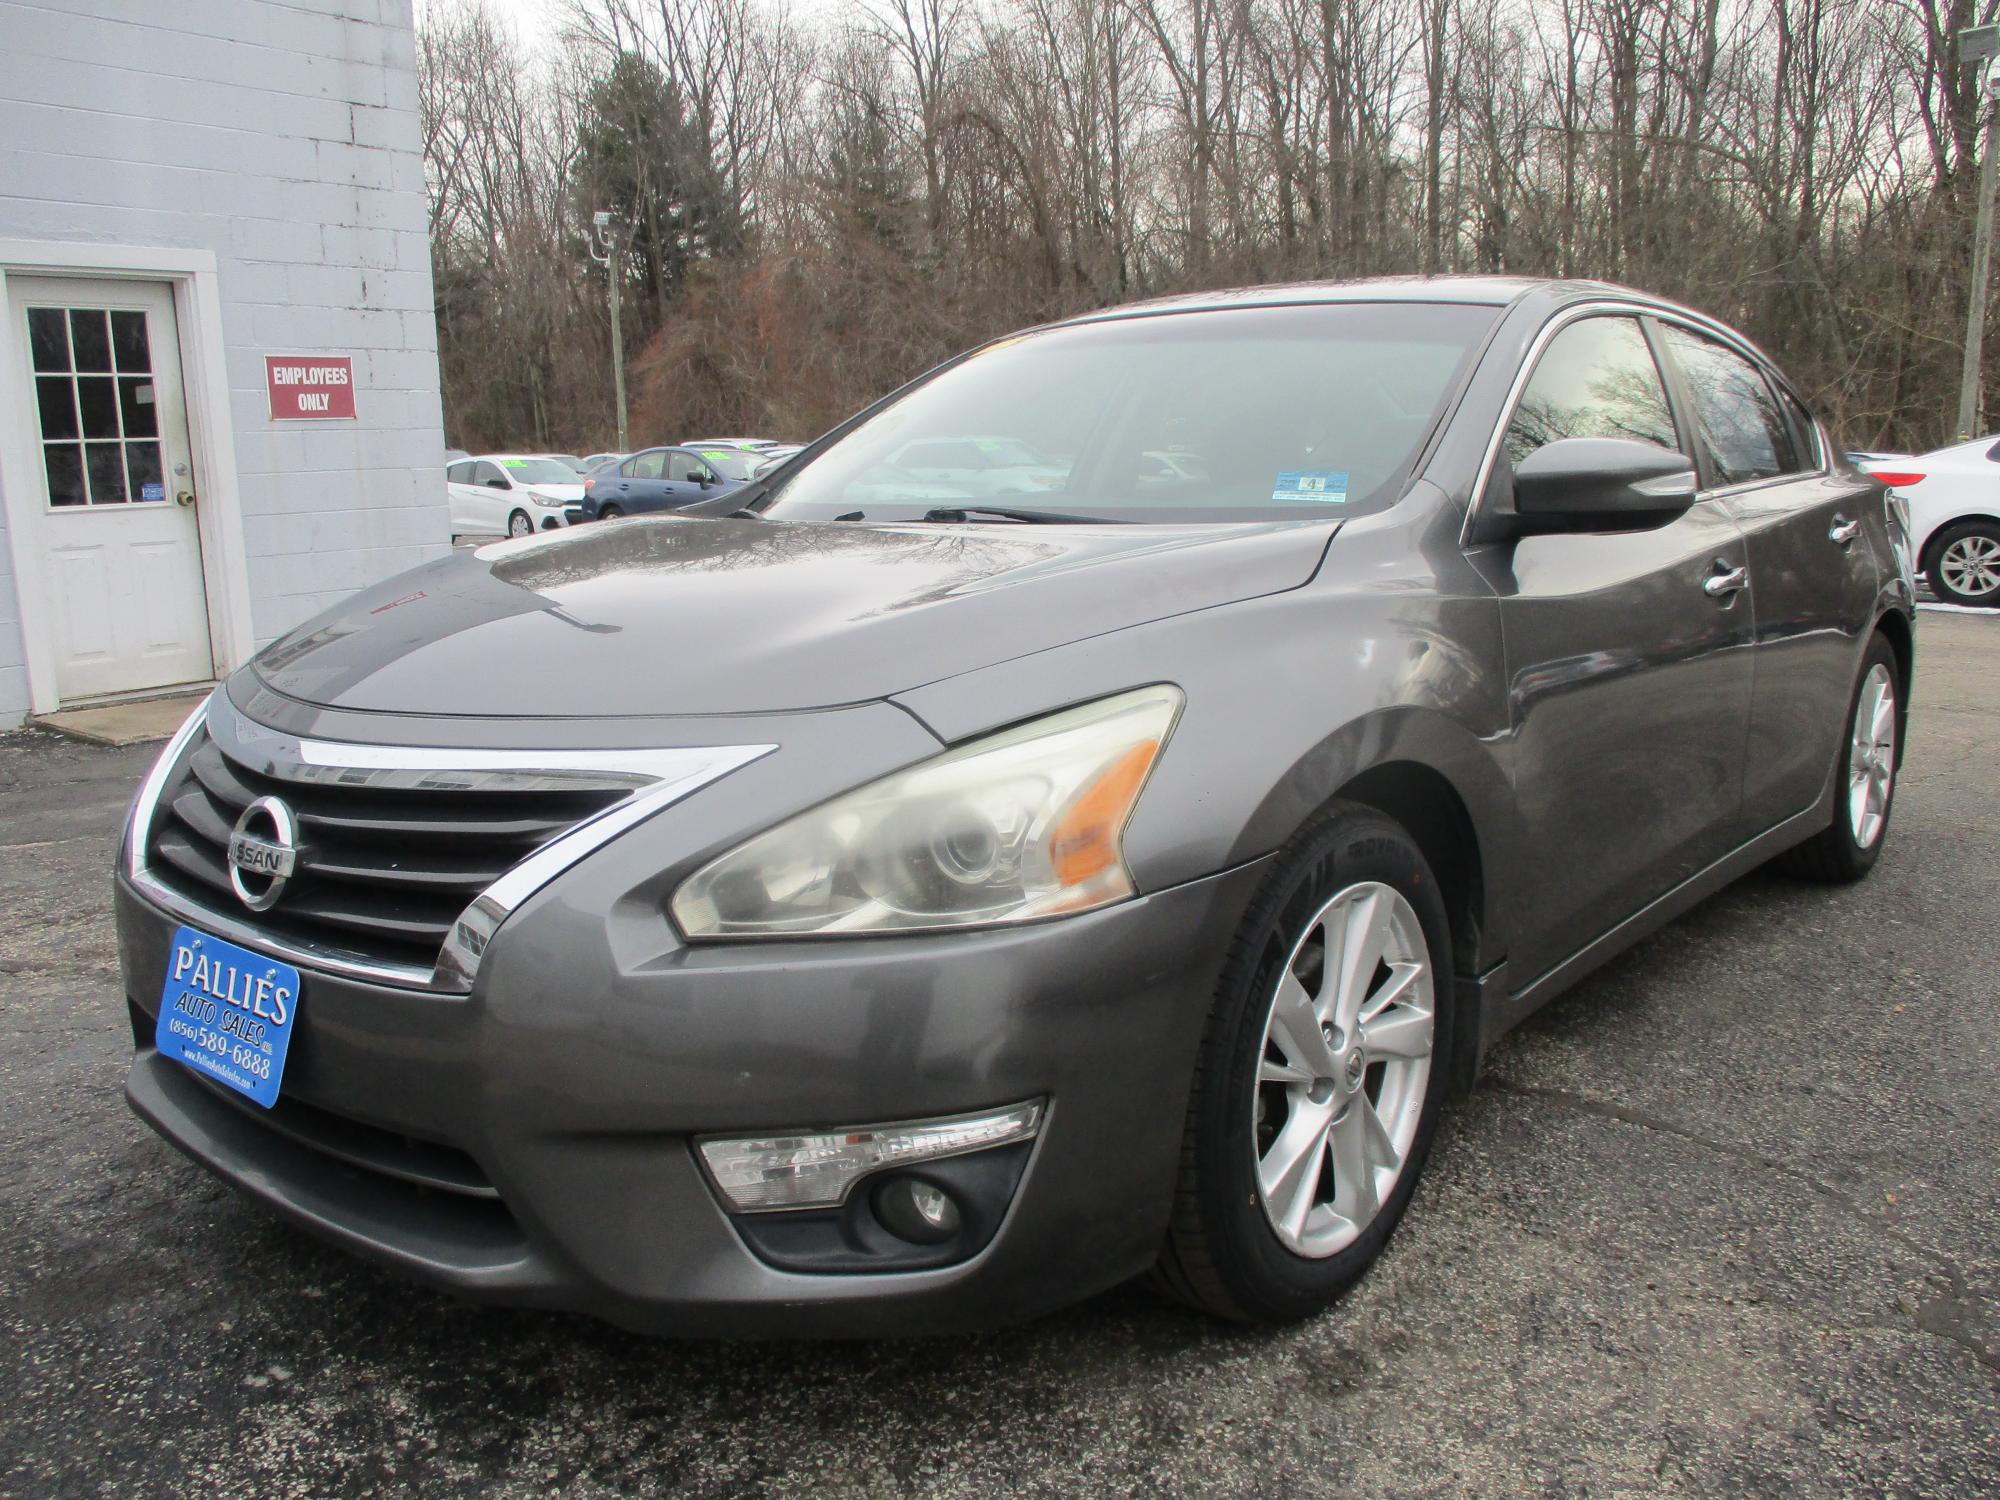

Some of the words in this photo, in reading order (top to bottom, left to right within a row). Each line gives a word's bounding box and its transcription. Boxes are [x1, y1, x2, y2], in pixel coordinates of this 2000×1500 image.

[273, 366, 349, 385] EMPLOYEES
[297, 393, 330, 411] ONLY
[1307, 478, 1317, 490] 4
[174, 991, 217, 1025] AUTO
[219, 1008, 266, 1048] SALES
